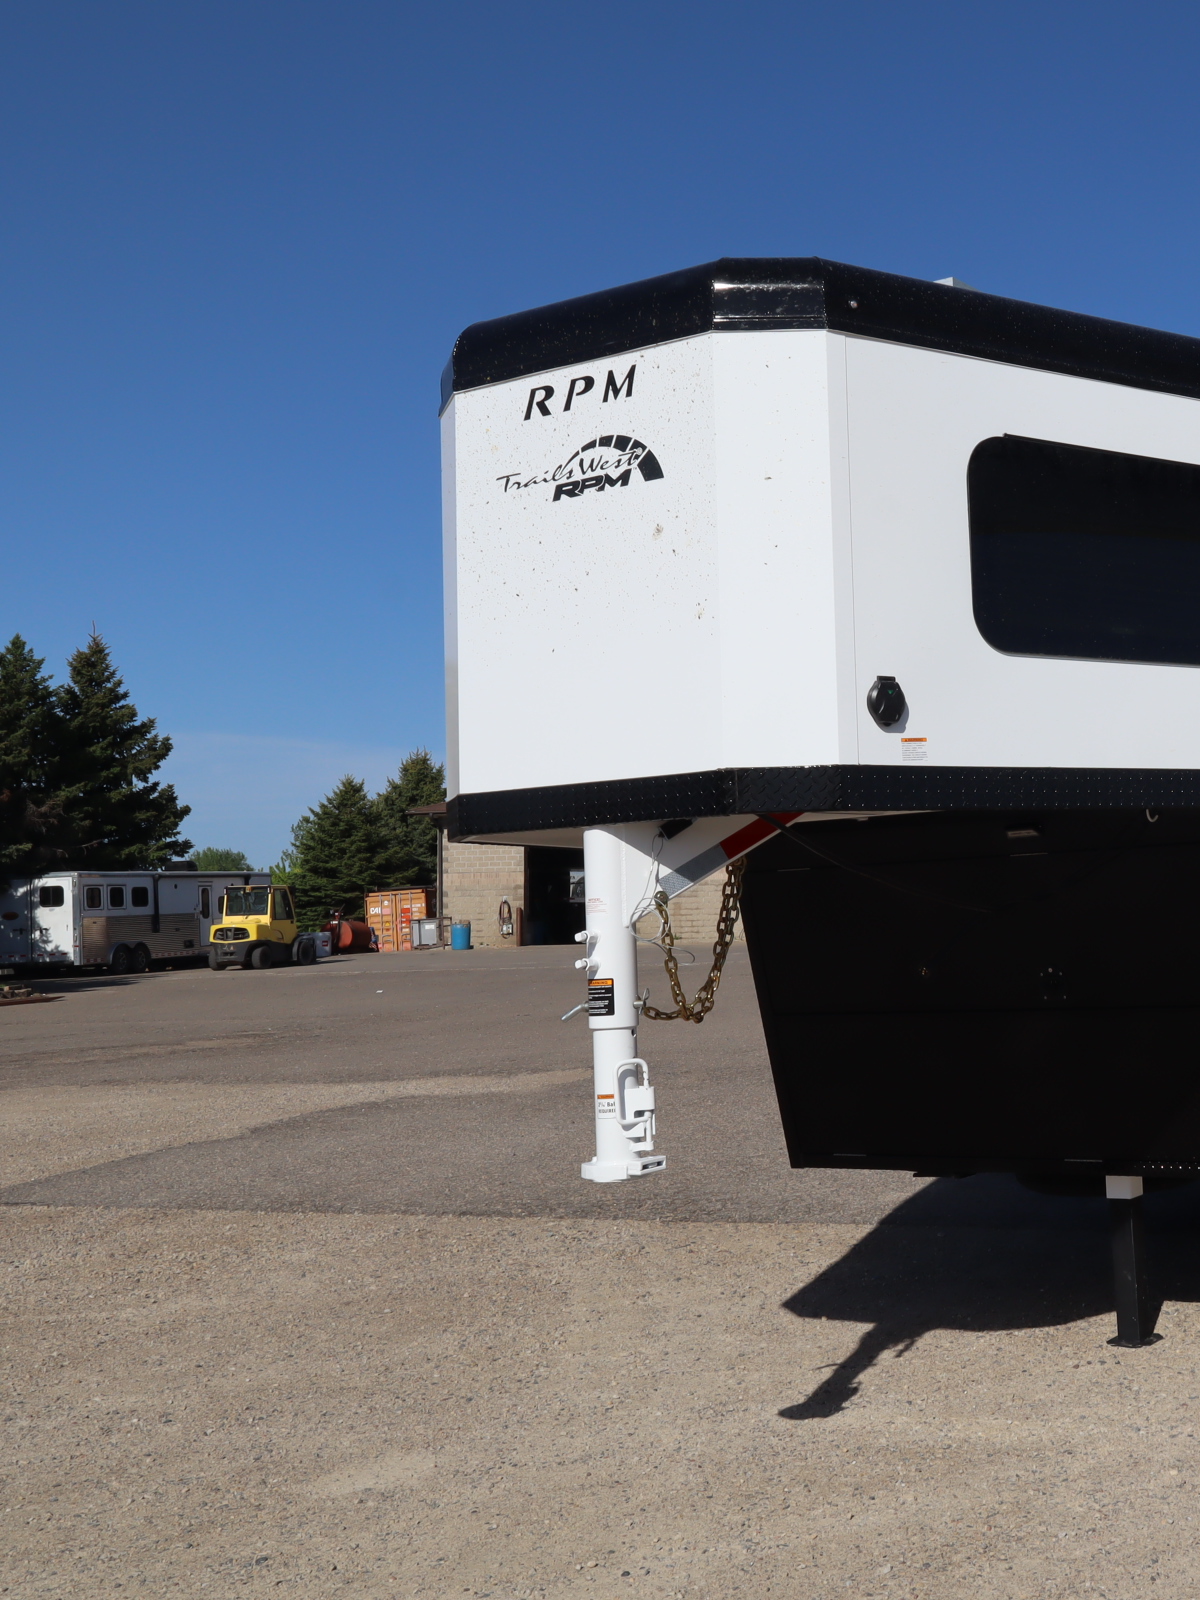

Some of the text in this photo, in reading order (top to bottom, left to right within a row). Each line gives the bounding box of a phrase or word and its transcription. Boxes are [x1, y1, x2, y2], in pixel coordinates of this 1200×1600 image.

[523, 364, 637, 421] RPM
[496, 448, 641, 493] Trails West
[552, 468, 632, 502] RPM
